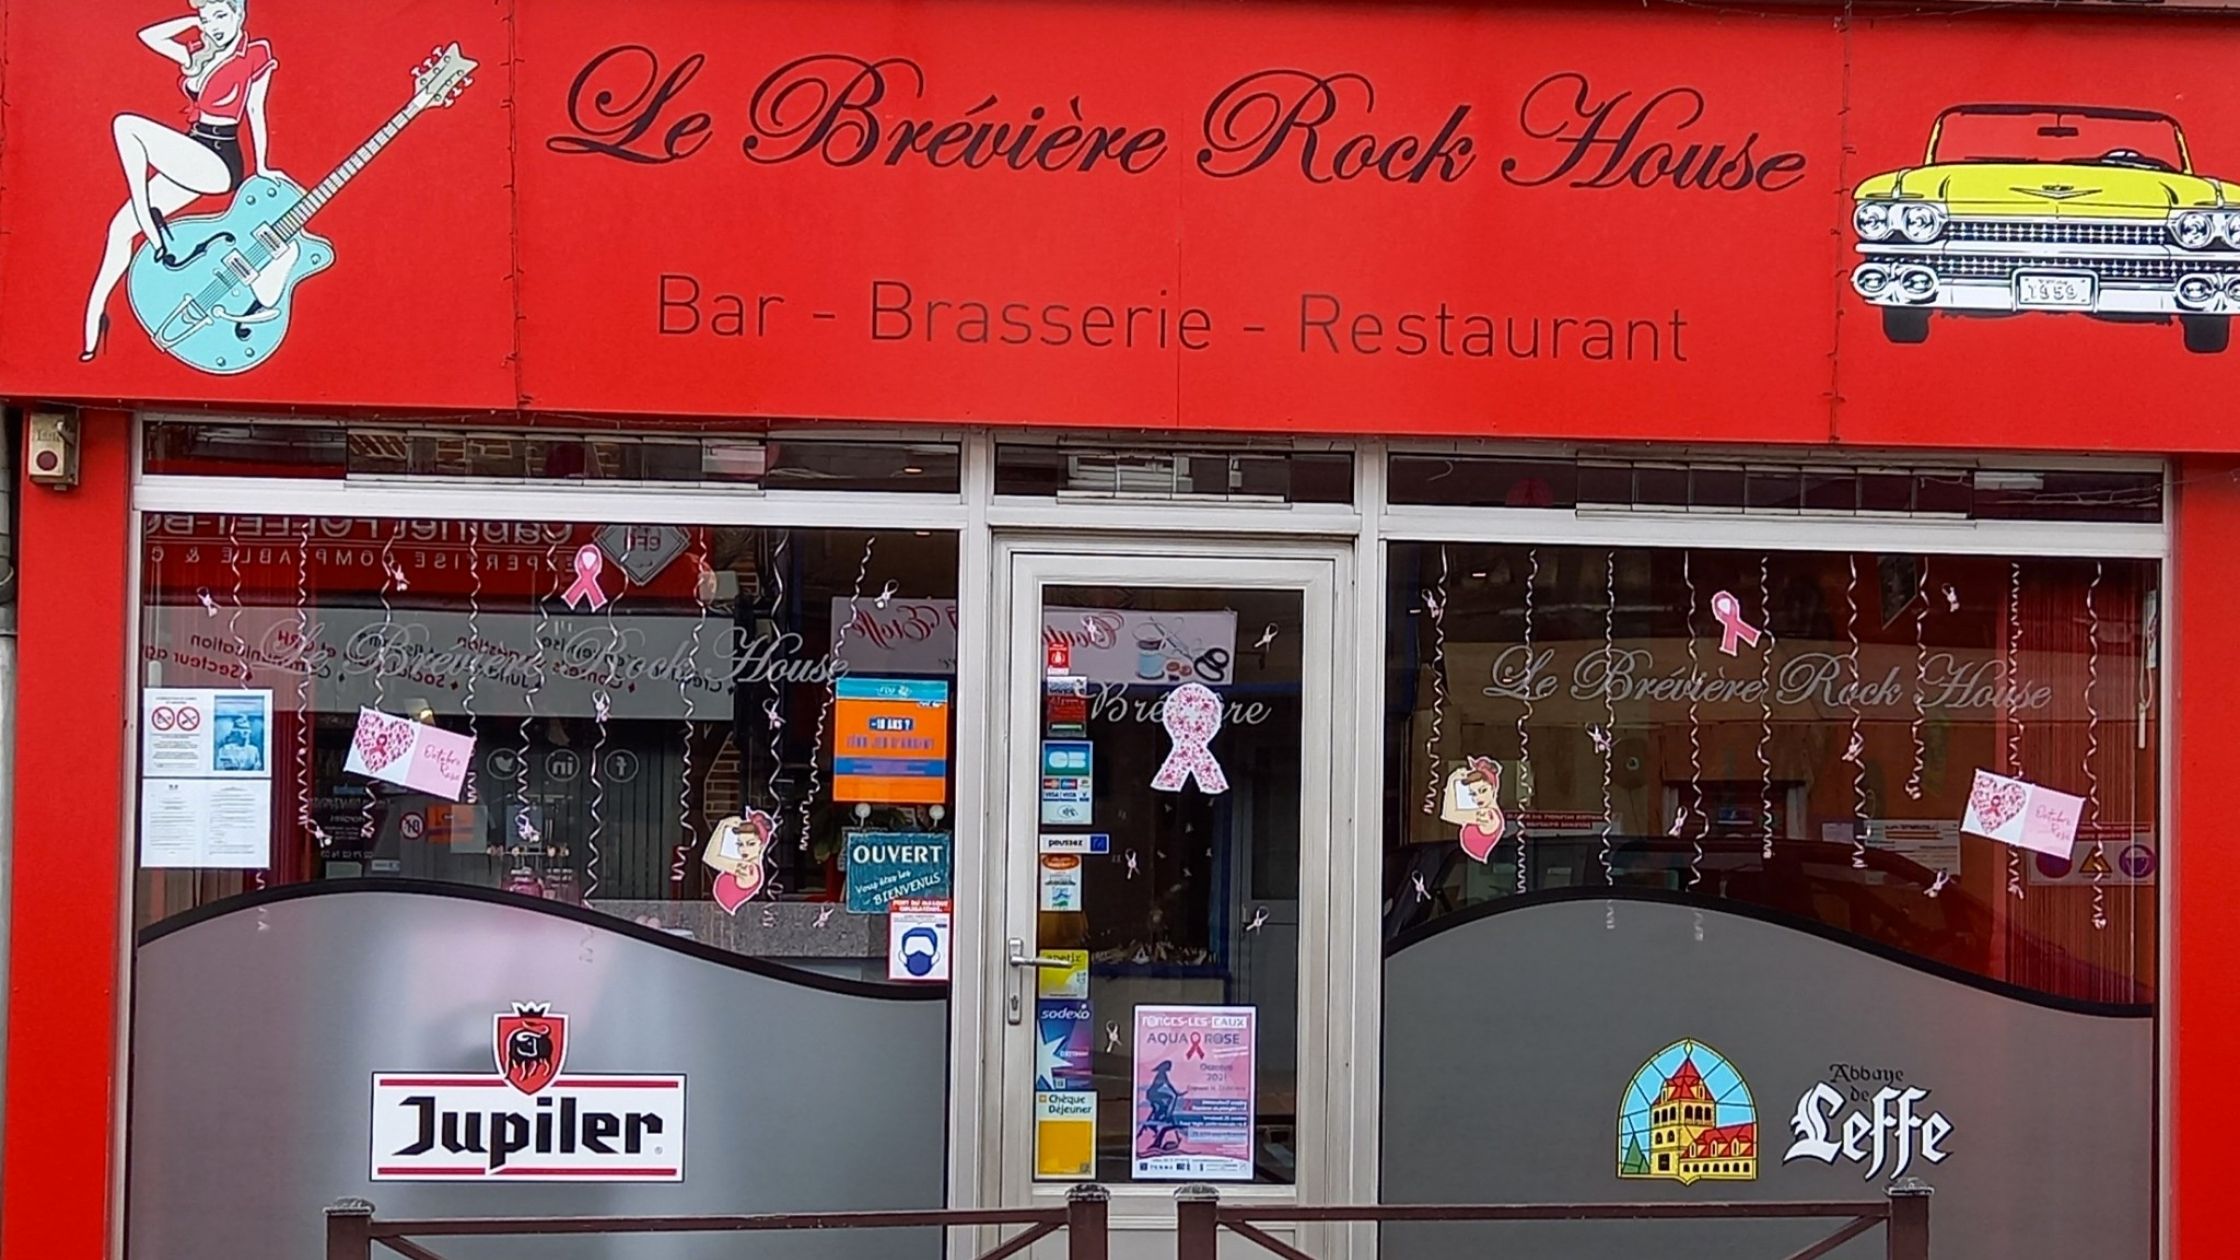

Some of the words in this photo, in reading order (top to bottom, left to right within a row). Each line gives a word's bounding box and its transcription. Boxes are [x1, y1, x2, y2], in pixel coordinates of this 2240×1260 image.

[546, 44, 713, 166] Le
[743, 53, 1168, 174] Brévière
[1196, 69, 1477, 185] Rock
[1500, 72, 1808, 193] House
[658, 274, 785, 337] Bar
[871, 280, 1211, 350] Brasserie
[1300, 294, 1688, 362] Restaurant
[251, 617, 330, 676] Le
[343, 621, 545, 677] Brévière
[562, 625, 696, 684] Rock
[706, 626, 850, 684] House
[1483, 644, 1559, 701] Le
[1570, 648, 1763, 703] Brévière
[1776, 652, 1903, 707] Rock
[1913, 653, 2052, 709] House
[1076, 680, 1272, 724] Brére
[853, 844, 944, 864] OUVERT
[1048, 839, 1083, 848] poussez
[855, 882, 879, 895] Vous
[897, 869, 912, 881] les
[872, 871, 942, 906] BIENVENUS
[1041, 1003, 1090, 1019] sodexo
[1146, 1033, 1188, 1045] AQUA
[1204, 1033, 1240, 1045] ROSE
[1829, 1063, 1904, 1084] Abbaye
[1048, 1093, 1086, 1105] Chèque
[1851, 1086, 1870, 1102] de
[1048, 1104, 1092, 1116] Déjeuner
[391, 1096, 663, 1170] Jupiler
[1782, 1082, 1953, 1181] Leffe
